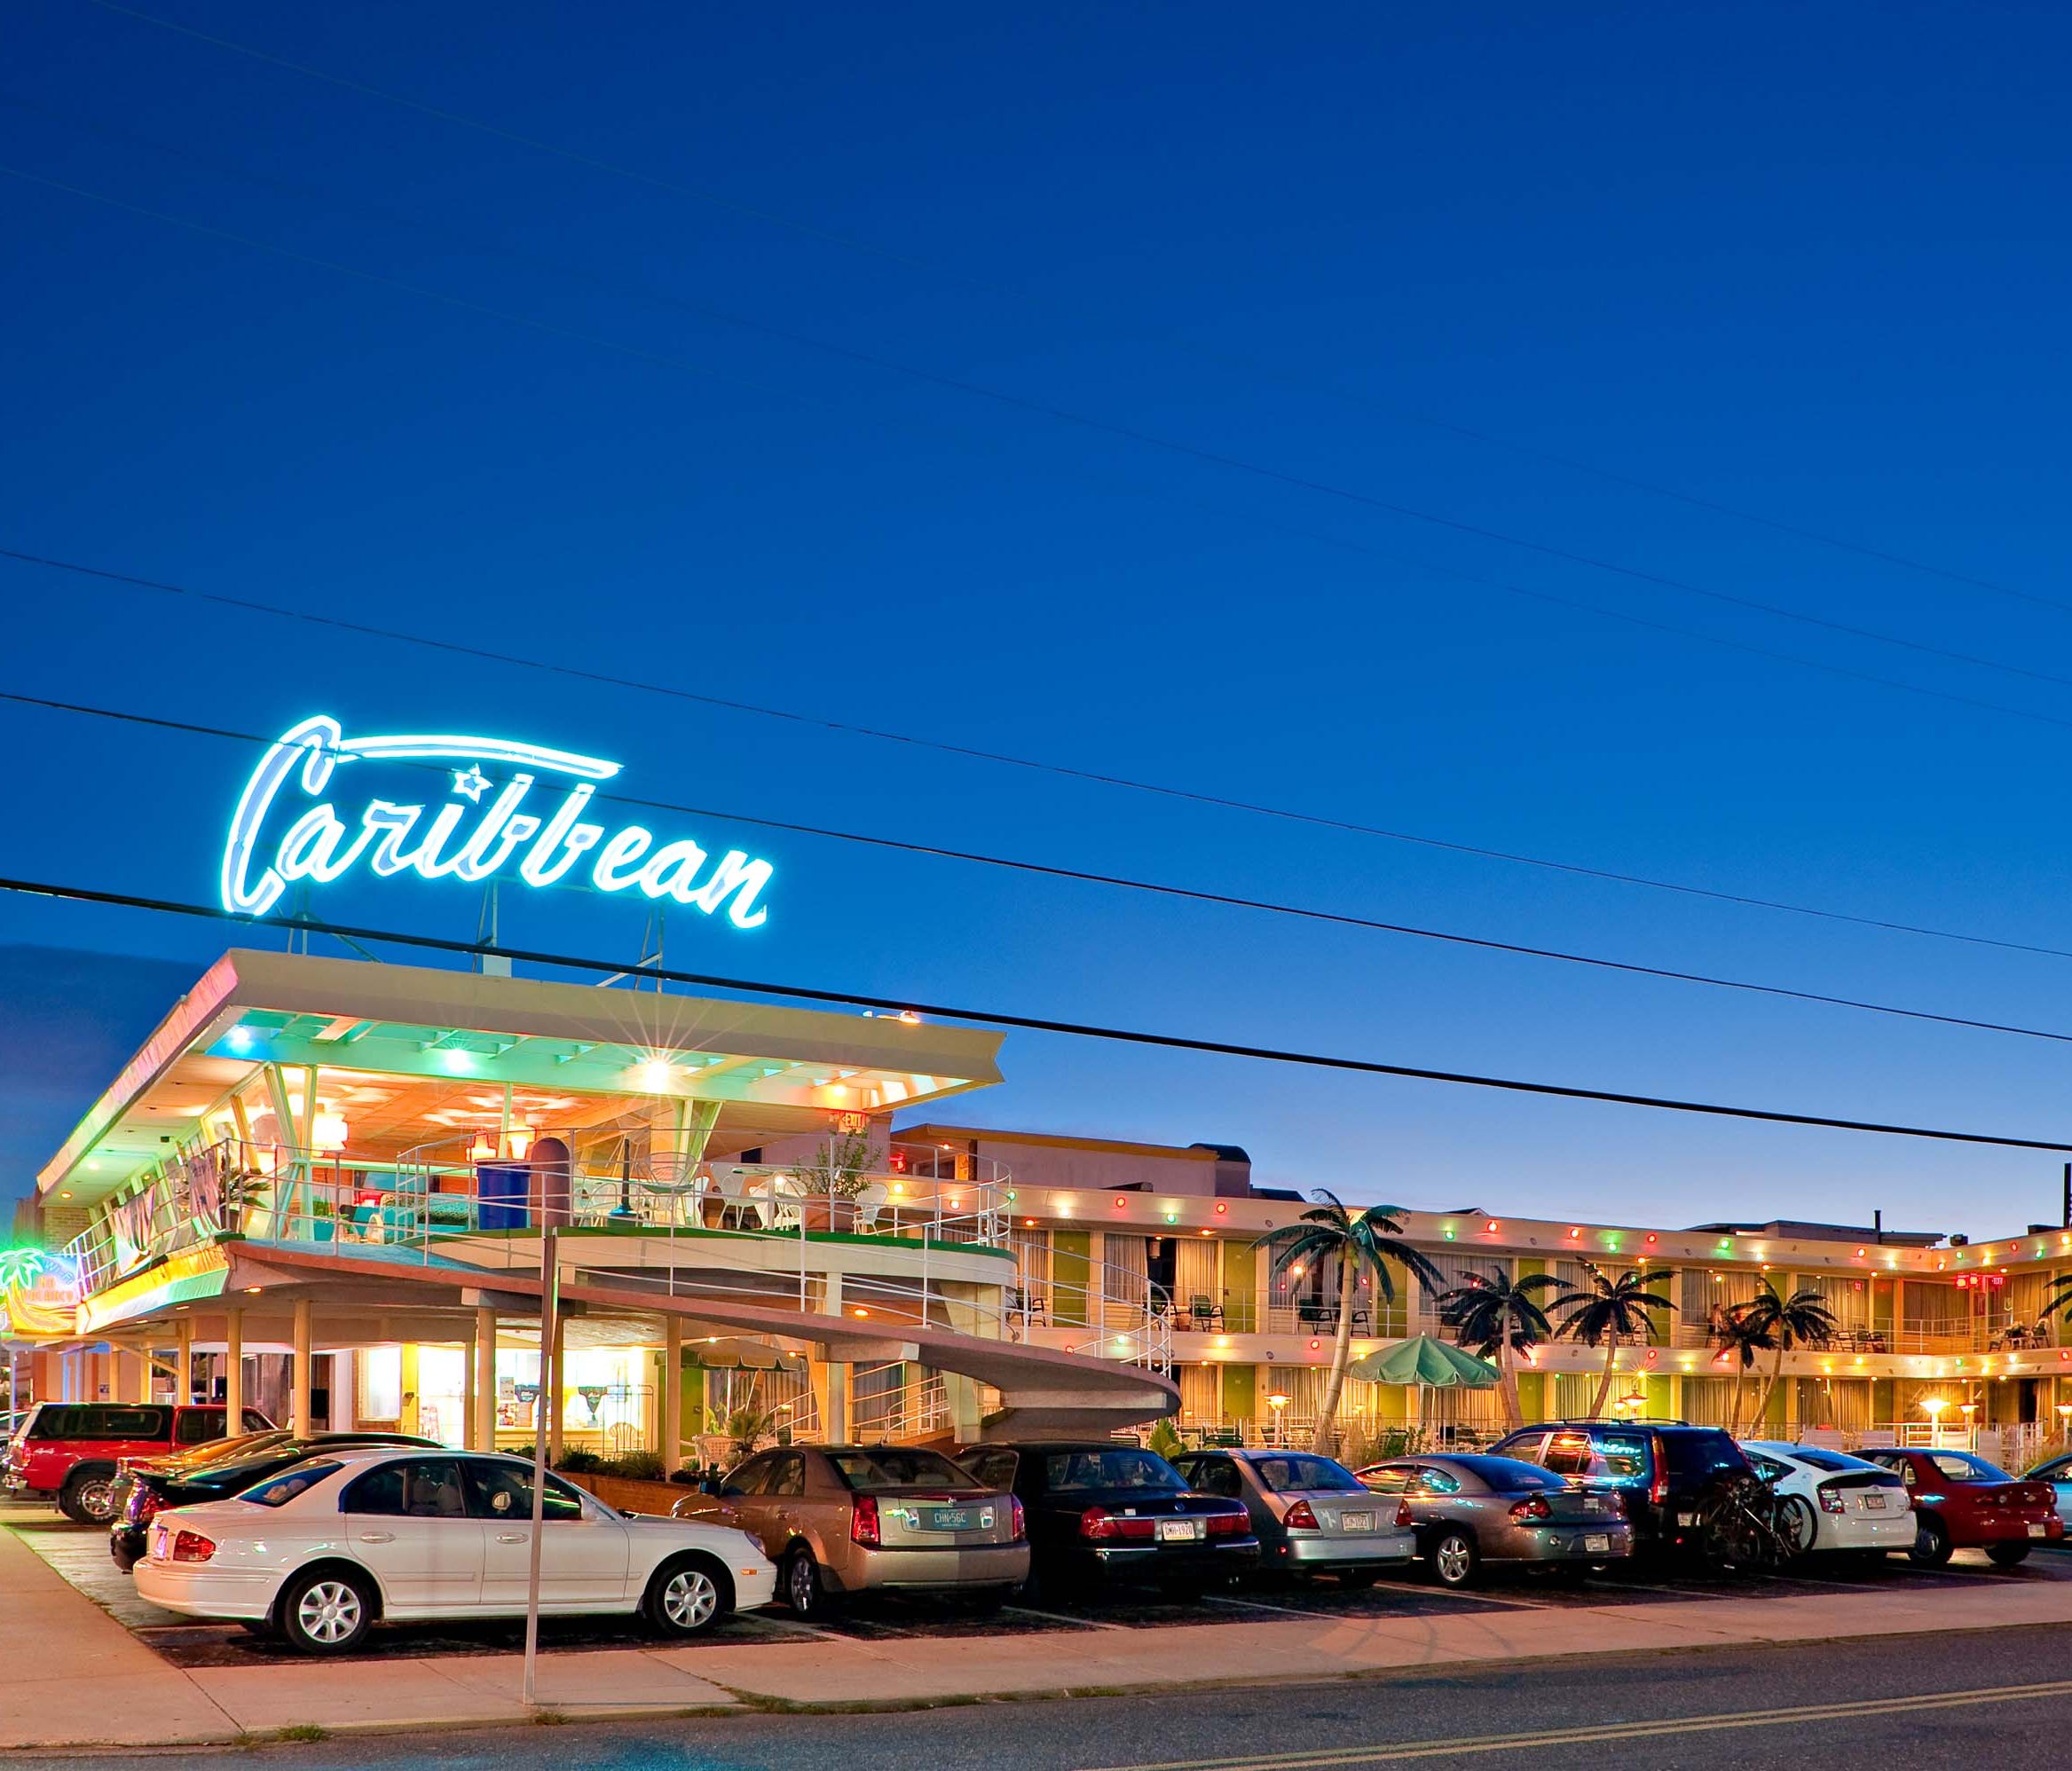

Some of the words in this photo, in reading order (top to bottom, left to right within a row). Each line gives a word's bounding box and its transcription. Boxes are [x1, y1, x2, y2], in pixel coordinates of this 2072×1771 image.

[221, 714, 775, 929] Caribbean
[846, 1113, 863, 1127] EXIT
[40, 1276, 55, 1288] NO
